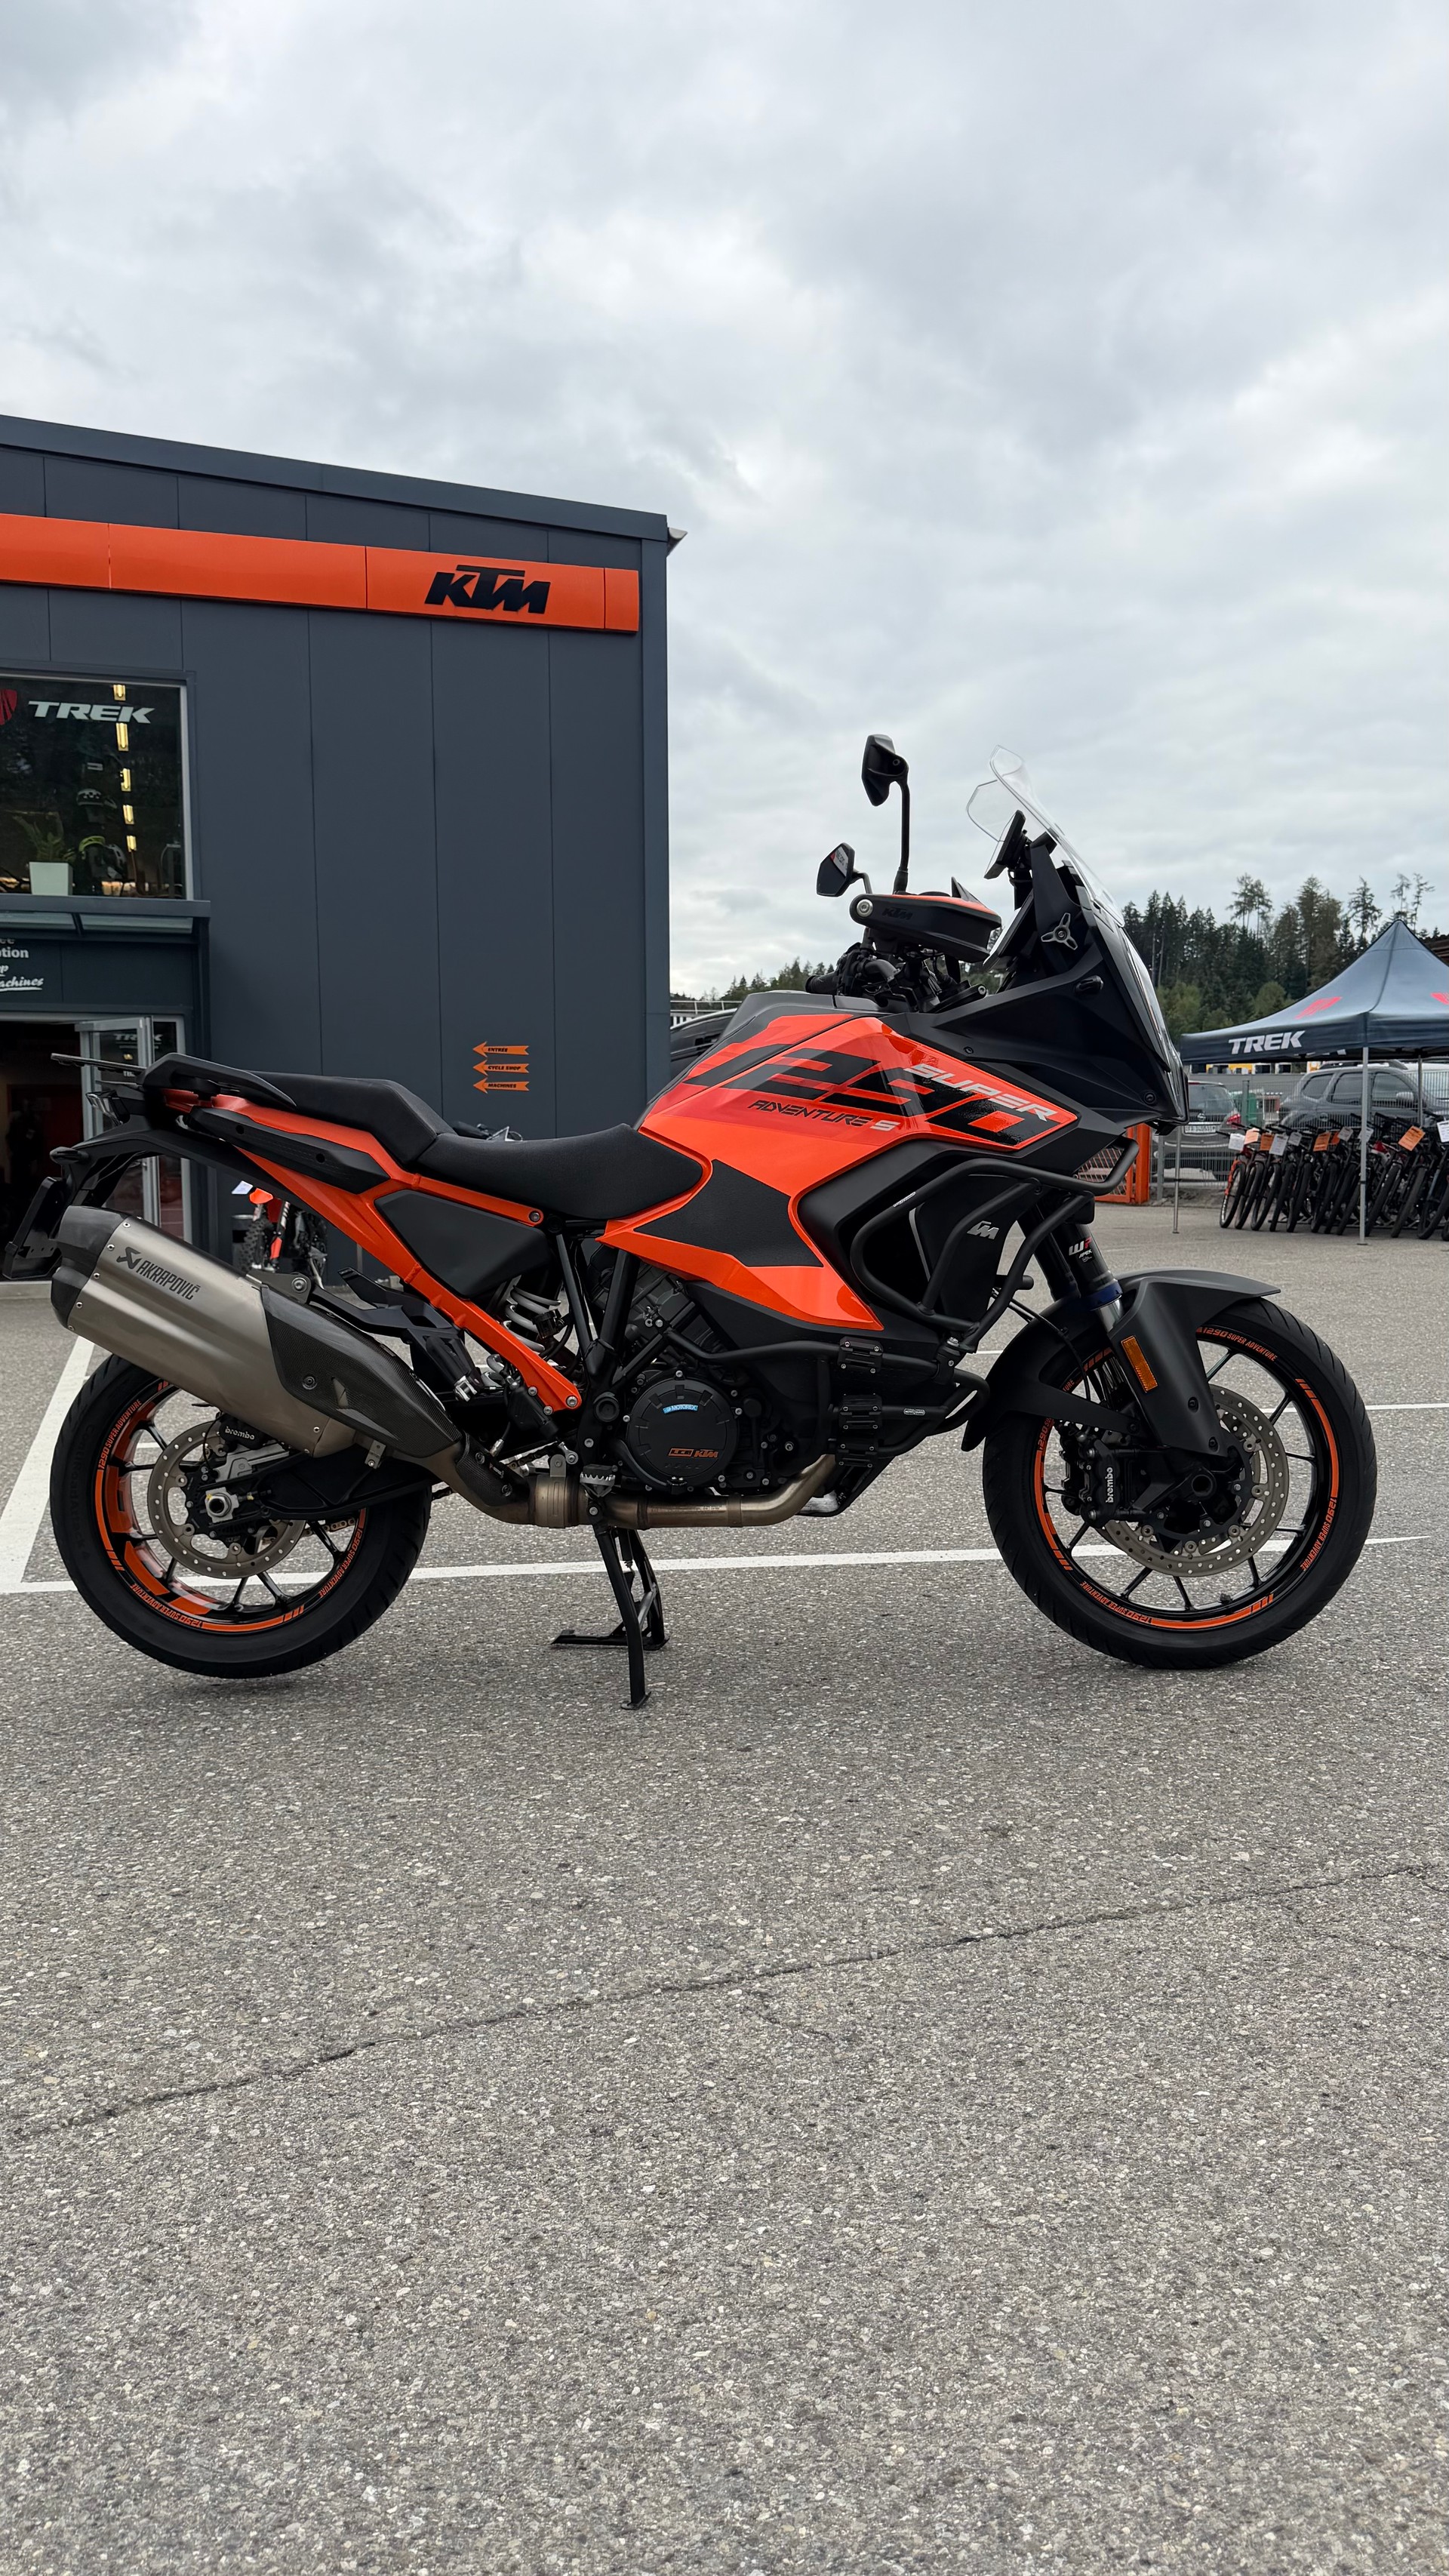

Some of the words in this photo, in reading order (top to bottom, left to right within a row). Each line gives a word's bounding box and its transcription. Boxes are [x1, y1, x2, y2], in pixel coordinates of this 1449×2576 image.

[424, 565, 551, 614] KTM
[29, 700, 155, 724] TREK
[114, 1033, 164, 1042] TRK
[1229, 1030, 1306, 1055] TREK
[903, 1063, 1058, 1122] SUPER
[746, 1099, 875, 1128] ADVENTURE
[870, 1121, 901, 1131] S
[1203, 1328, 1229, 1338] 1290
[1226, 1333, 1247, 1345] SUPER
[1245, 1340, 1278, 1362] ADVENTURE
[97, 1446, 110, 1470] 1290
[106, 1429, 120, 1448] SUPER
[115, 1399, 143, 1430] ADVENTURE
[225, 1426, 255, 1440] brembo
[694, 1449, 718, 1458] KTM
[1105, 1467, 1114, 1503] brembo
[1325, 1497, 1337, 1523] 1290
[352, 1528, 363, 1551] 1290
[1318, 1522, 1331, 1541] SUPER
[342, 1550, 355, 1570] SUPER
[1300, 1540, 1322, 1571] ADVENTURE
[318, 1567, 345, 1599] ADVENTURE
[1080, 1580, 1109, 1605] ADVENTURE
[130, 1583, 164, 1612] ADVENTURE
[1109, 1602, 1128, 1616] SUPER
[178, 1615, 202, 1628] 1290
[1127, 1610, 1152, 1624] 1290
